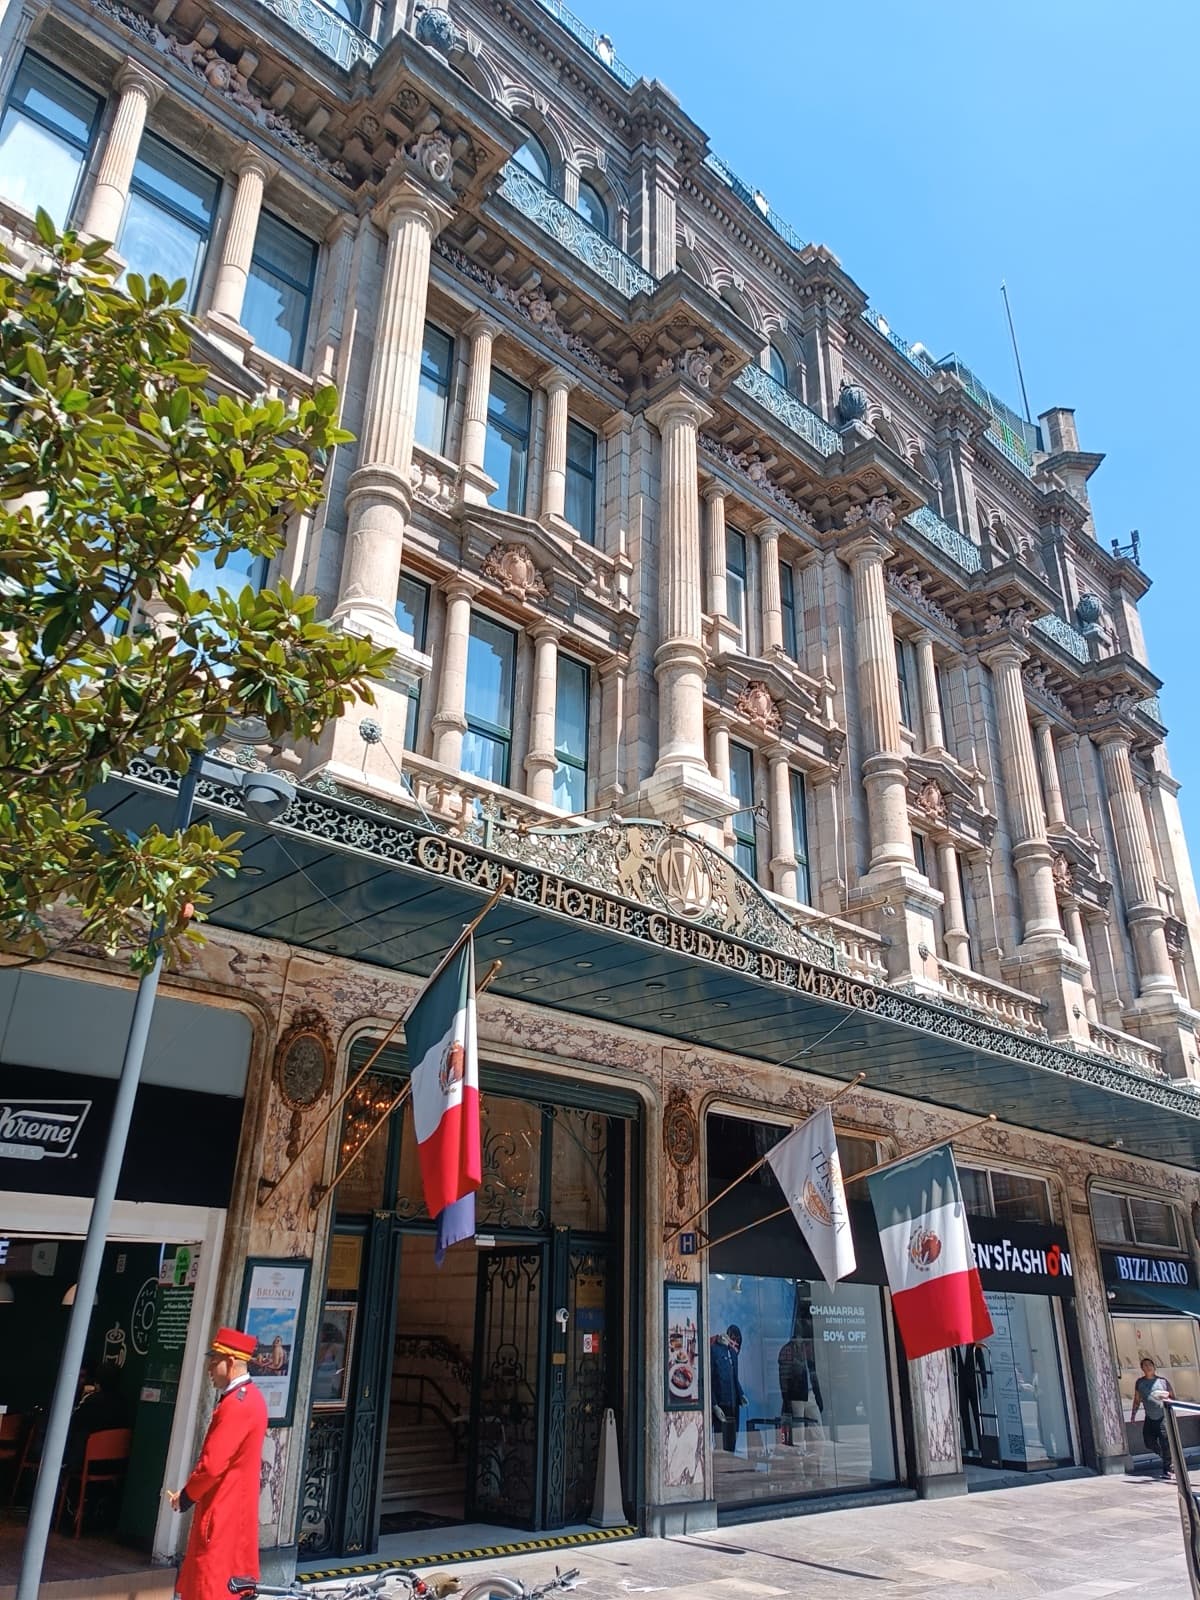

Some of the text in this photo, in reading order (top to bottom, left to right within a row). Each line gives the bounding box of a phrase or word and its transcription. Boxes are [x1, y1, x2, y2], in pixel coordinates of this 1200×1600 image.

[417, 836, 878, 1009] GRAN HOTEL CIUDAD DE MEXICO
[682, 1235, 693, 1253] H
[675, 1263, 688, 1280] 82
[1116, 1256, 1188, 1285] BIZZARRO
[809, 1305, 865, 1316] CHAMARRAS
[823, 1331, 867, 1343] 50% OFF
